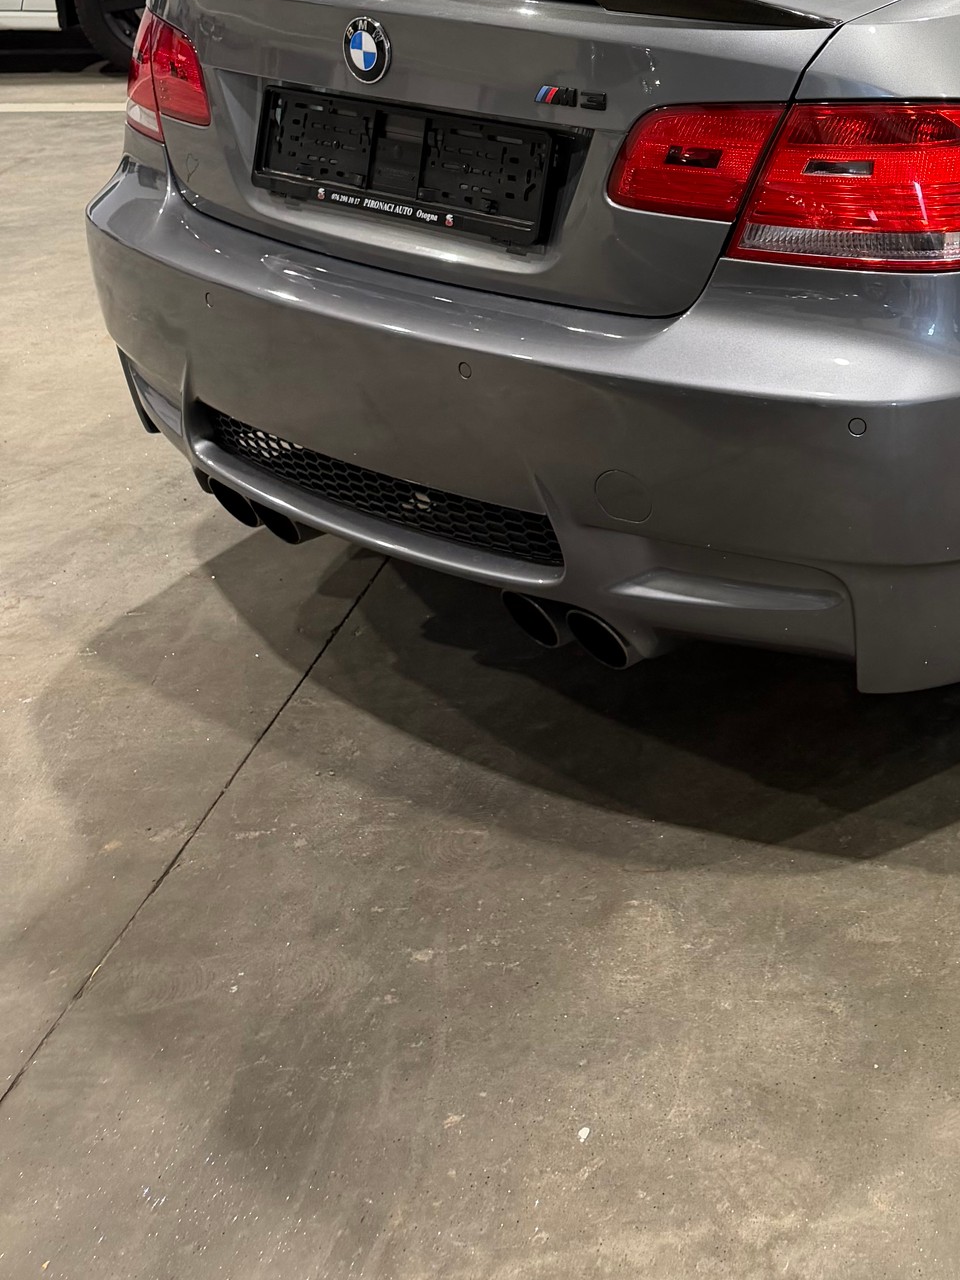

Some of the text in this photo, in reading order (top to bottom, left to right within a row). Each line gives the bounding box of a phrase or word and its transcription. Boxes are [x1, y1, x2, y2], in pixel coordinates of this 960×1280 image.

[346, 19, 384, 43] BMW
[548, 86, 607, 111] M3
[363, 198, 395, 212] PIRONACI
[394, 205, 413, 216] AUTO
